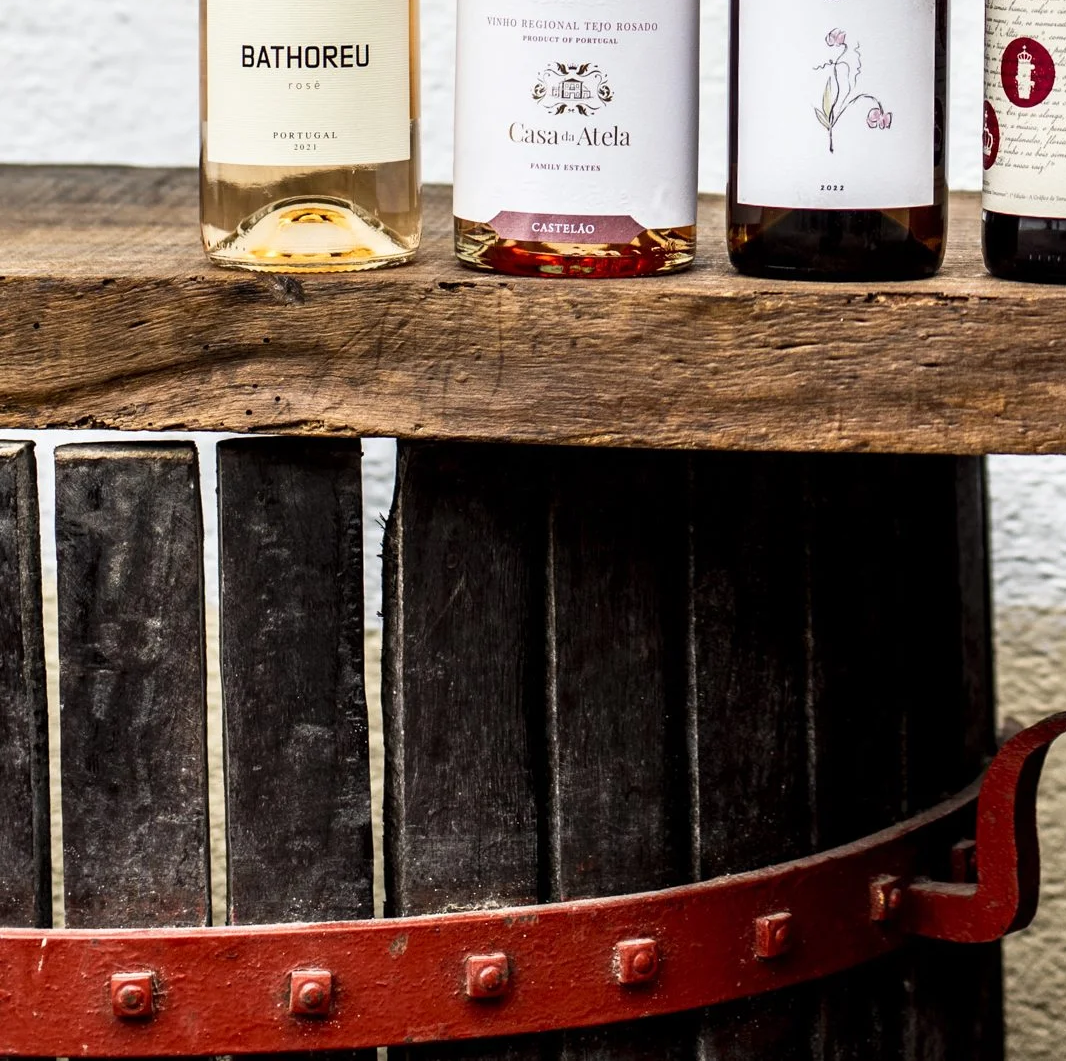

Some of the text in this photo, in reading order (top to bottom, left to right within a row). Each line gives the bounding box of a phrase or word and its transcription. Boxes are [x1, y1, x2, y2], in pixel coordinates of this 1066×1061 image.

[487, 16, 658, 32] VINHO REGIONAL TEJO ROSADO
[522, 35, 560, 43] PRODUCT
[575, 37, 619, 45] PORTUGAL
[241, 44, 370, 69] BATHOREU
[288, 80, 321, 90] rosé
[273, 131, 338, 140] PORTUGAL
[508, 121, 631, 147] Casa da Atela
[293, 143, 318, 151] 2021
[530, 162, 601, 172] FAMILY ESTATES
[531, 222, 595, 234] CASTELÃO
